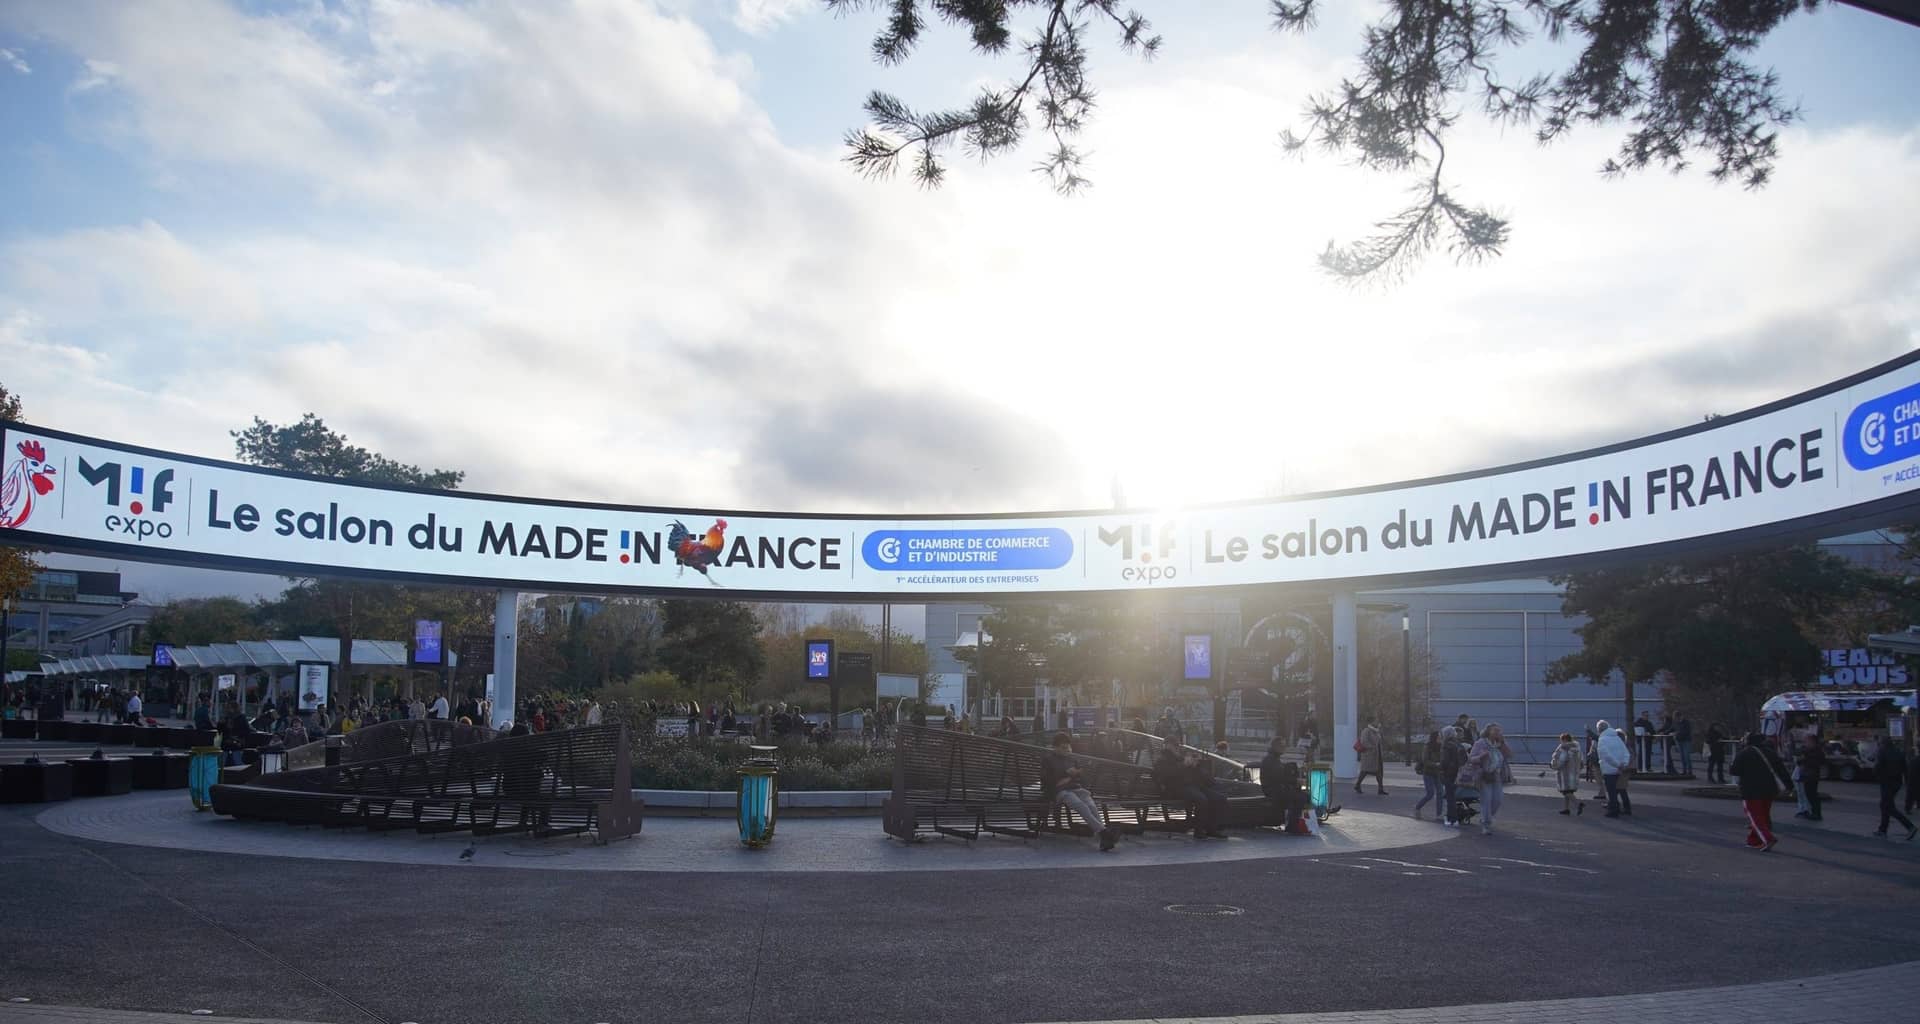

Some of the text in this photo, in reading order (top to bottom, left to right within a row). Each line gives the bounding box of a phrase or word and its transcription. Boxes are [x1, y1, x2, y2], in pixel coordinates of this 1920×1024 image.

[1894, 425, 1911, 446] ET
[1204, 530, 1249, 564] Le
[1261, 518, 1368, 560] salon
[1381, 509, 1432, 549] du
[1448, 486, 1576, 543] MADE
[1646, 428, 1824, 516] FRANCE
[105, 513, 172, 541] expo
[208, 488, 260, 532] Le
[275, 502, 393, 546] salon
[407, 513, 462, 552] du
[478, 520, 608, 562] MADE
[675, 533, 841, 570] ANCE
[908, 536, 1050, 549] CHAMBRE DE COMMERCE
[908, 551, 998, 563] ET D'INDUSTRIE
[907, 574, 967, 584] ACCÉLÉRATEUR
[969, 575, 984, 584] DES
[986, 575, 1040, 584] ENTREPRISES
[1122, 565, 1177, 584] expo
